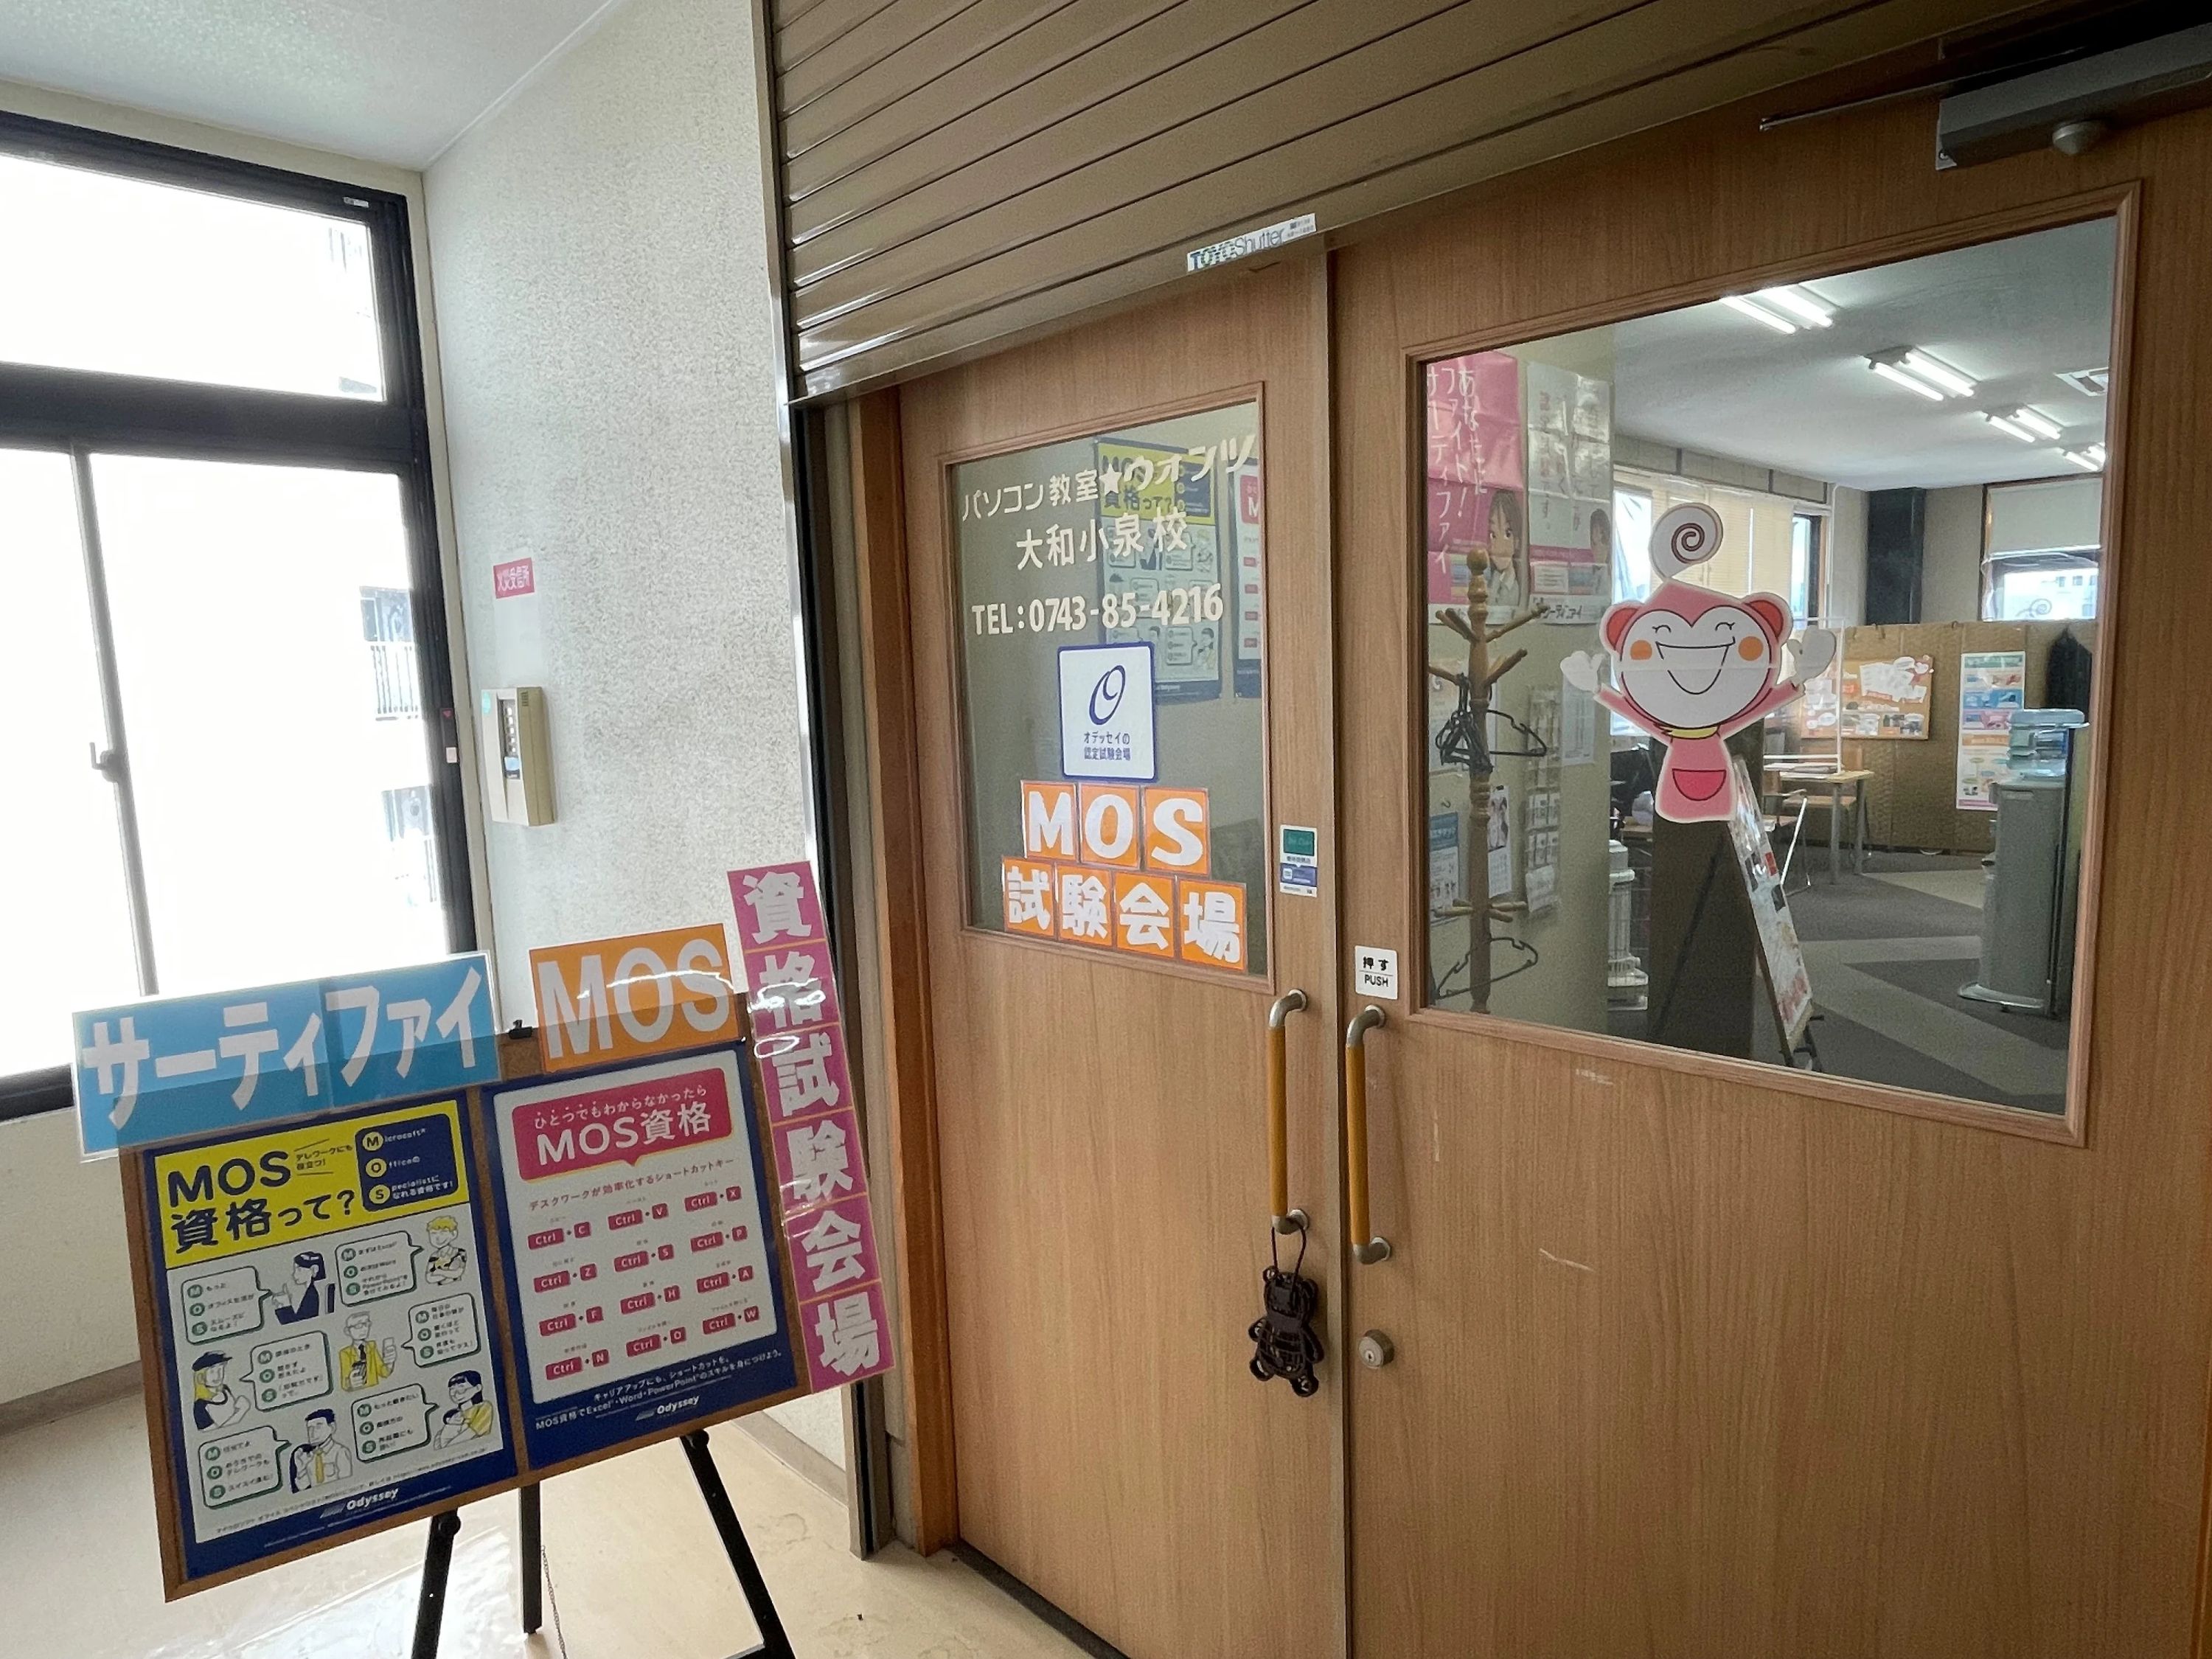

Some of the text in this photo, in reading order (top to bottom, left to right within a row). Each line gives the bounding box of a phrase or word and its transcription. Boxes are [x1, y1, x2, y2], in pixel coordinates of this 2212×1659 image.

[963, 469, 1099, 522] パソコン教室
[1016, 507, 1188, 571] 大和小泉校
[1084, 729, 1130, 745] オデッセイの
[1029, 790, 1205, 866] MOS
[1007, 866, 1241, 964] 試験会場
[1363, 956, 1388, 971] 押す
[1364, 974, 1389, 987] PUSH
[538, 939, 730, 1059] MOS
[82, 966, 482, 1130] サーティファイ
[535, 1085, 707, 1129] ひとつでもわからなかったら
[742, 871, 880, 1377] 資格試験会場
[537, 1101, 712, 1166] MOS資格
[167, 1150, 291, 1208] MOS
[691, 1196, 710, 1207] Ctrl
[170, 1189, 356, 1252] 資格って？
[615, 1214, 636, 1225] Ctrl
[535, 1234, 557, 1246] Ctrl
[697, 1237, 716, 1248] Ctrl
[621, 1256, 641, 1267] Ctrl
[540, 1276, 562, 1288] Ctrl
[703, 1277, 723, 1289] Ctrl
[627, 1297, 647, 1310] Ctrl
[547, 1319, 568, 1332] Ctrl
[709, 1318, 728, 1329] Ctrl
[633, 1340, 653, 1352] Ctrl
[553, 1361, 574, 1375] Ctrl
[657, 1395, 700, 1415] Odyssey
[347, 1488, 399, 1511] Odyssey
